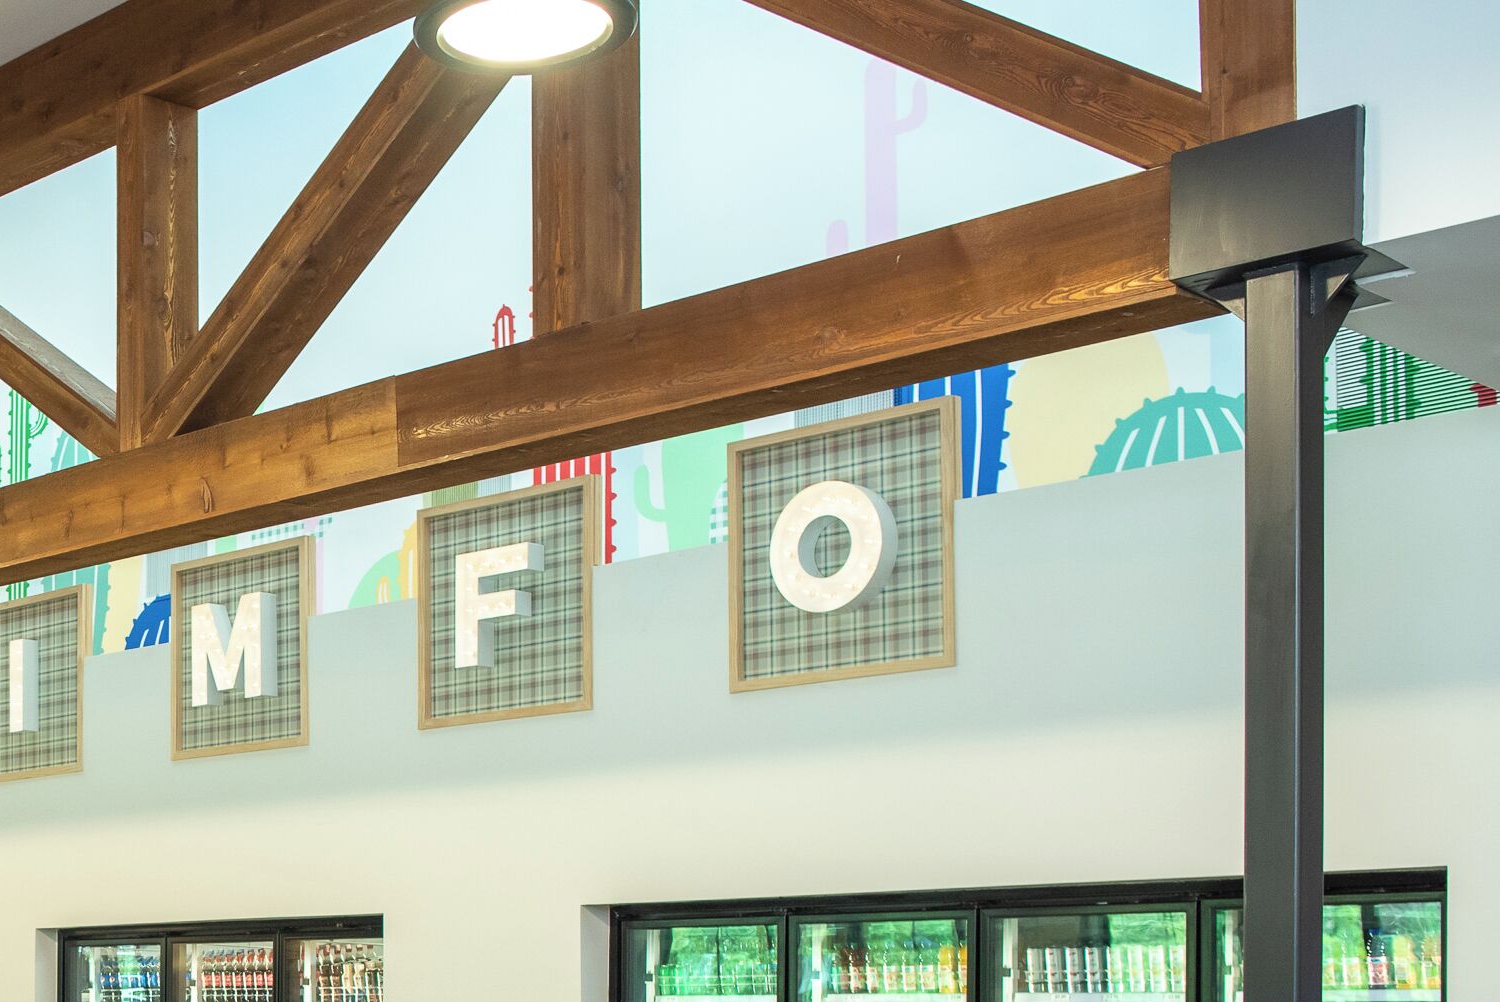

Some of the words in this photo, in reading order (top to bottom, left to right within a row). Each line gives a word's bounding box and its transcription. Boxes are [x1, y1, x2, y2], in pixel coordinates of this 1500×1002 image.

[191, 591, 276, 706] M
[455, 542, 544, 668] F
[769, 480, 897, 613] O
